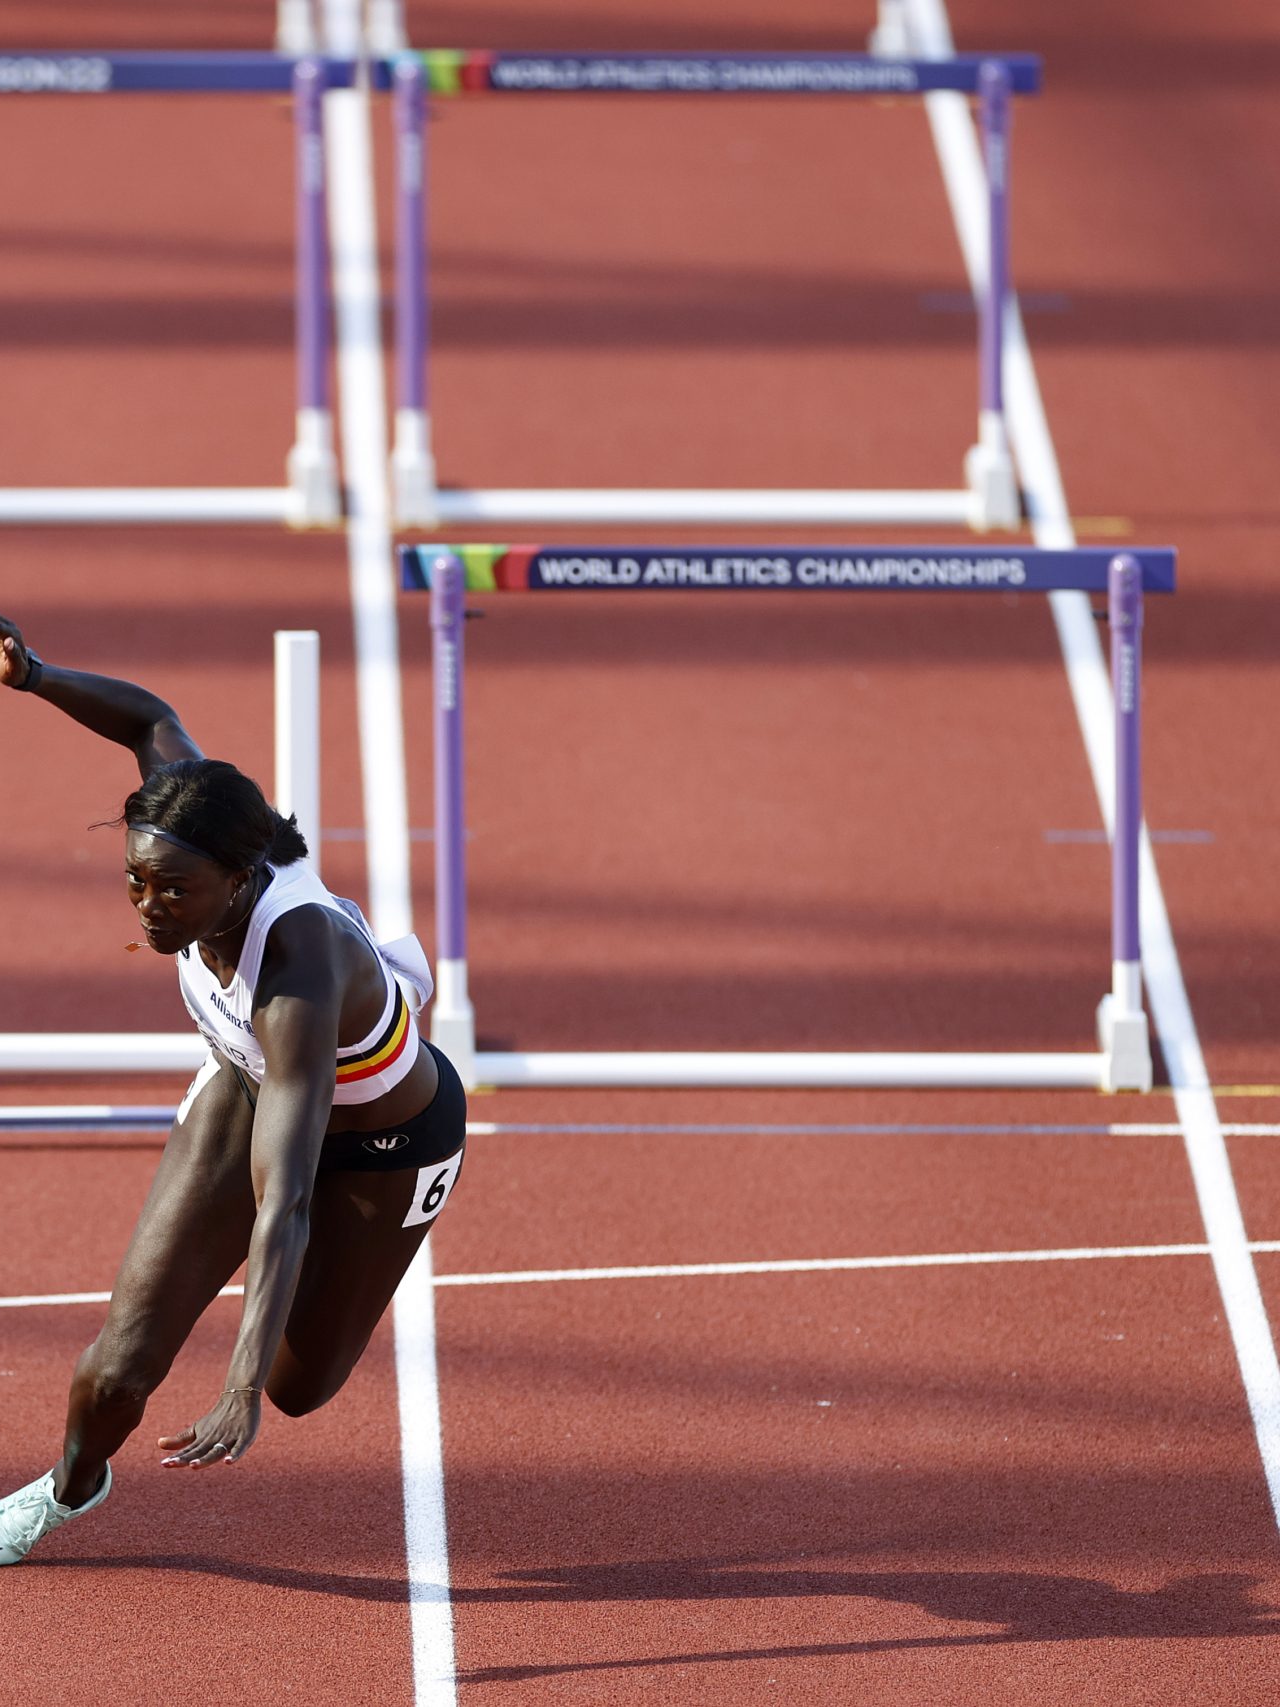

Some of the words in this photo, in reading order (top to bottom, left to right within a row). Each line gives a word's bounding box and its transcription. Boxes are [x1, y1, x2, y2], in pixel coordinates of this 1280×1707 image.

[538, 557, 640, 584] WORLD
[642, 557, 792, 584] ATHLETICS
[796, 557, 1026, 585] CHAMPIONSHIPS
[210, 992, 243, 1029] Allianz
[421, 1168, 450, 1214] 6
